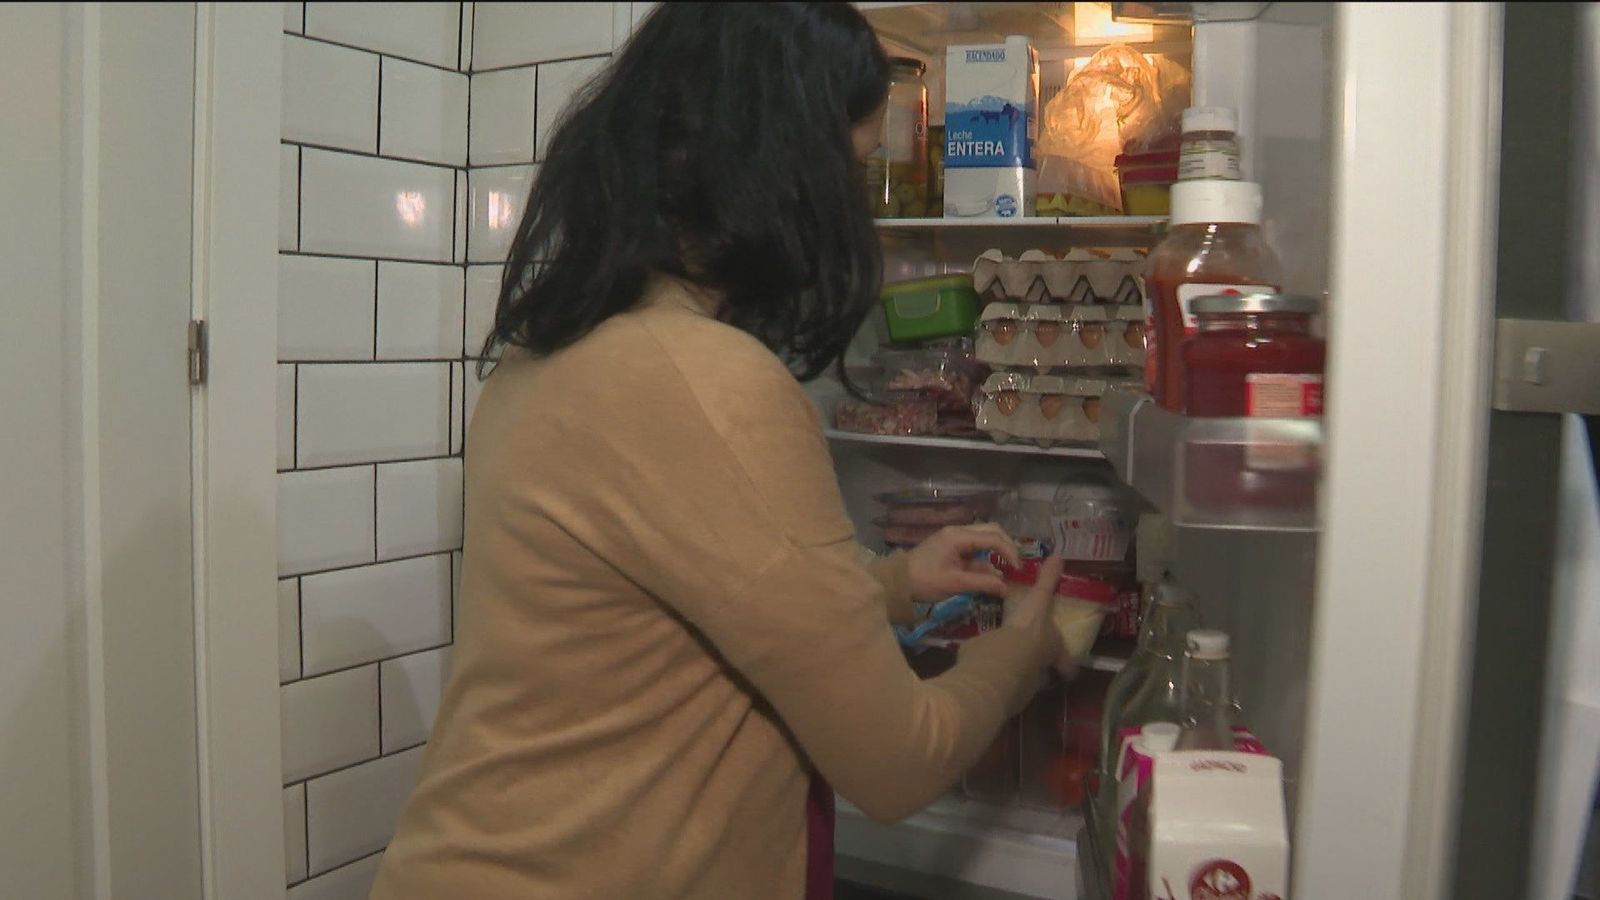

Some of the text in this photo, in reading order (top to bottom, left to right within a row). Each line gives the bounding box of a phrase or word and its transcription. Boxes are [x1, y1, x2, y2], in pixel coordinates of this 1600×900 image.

[965, 49, 1006, 62] HACENDADO
[948, 130, 973, 140] Leche
[947, 141, 1005, 157] ENTERA
